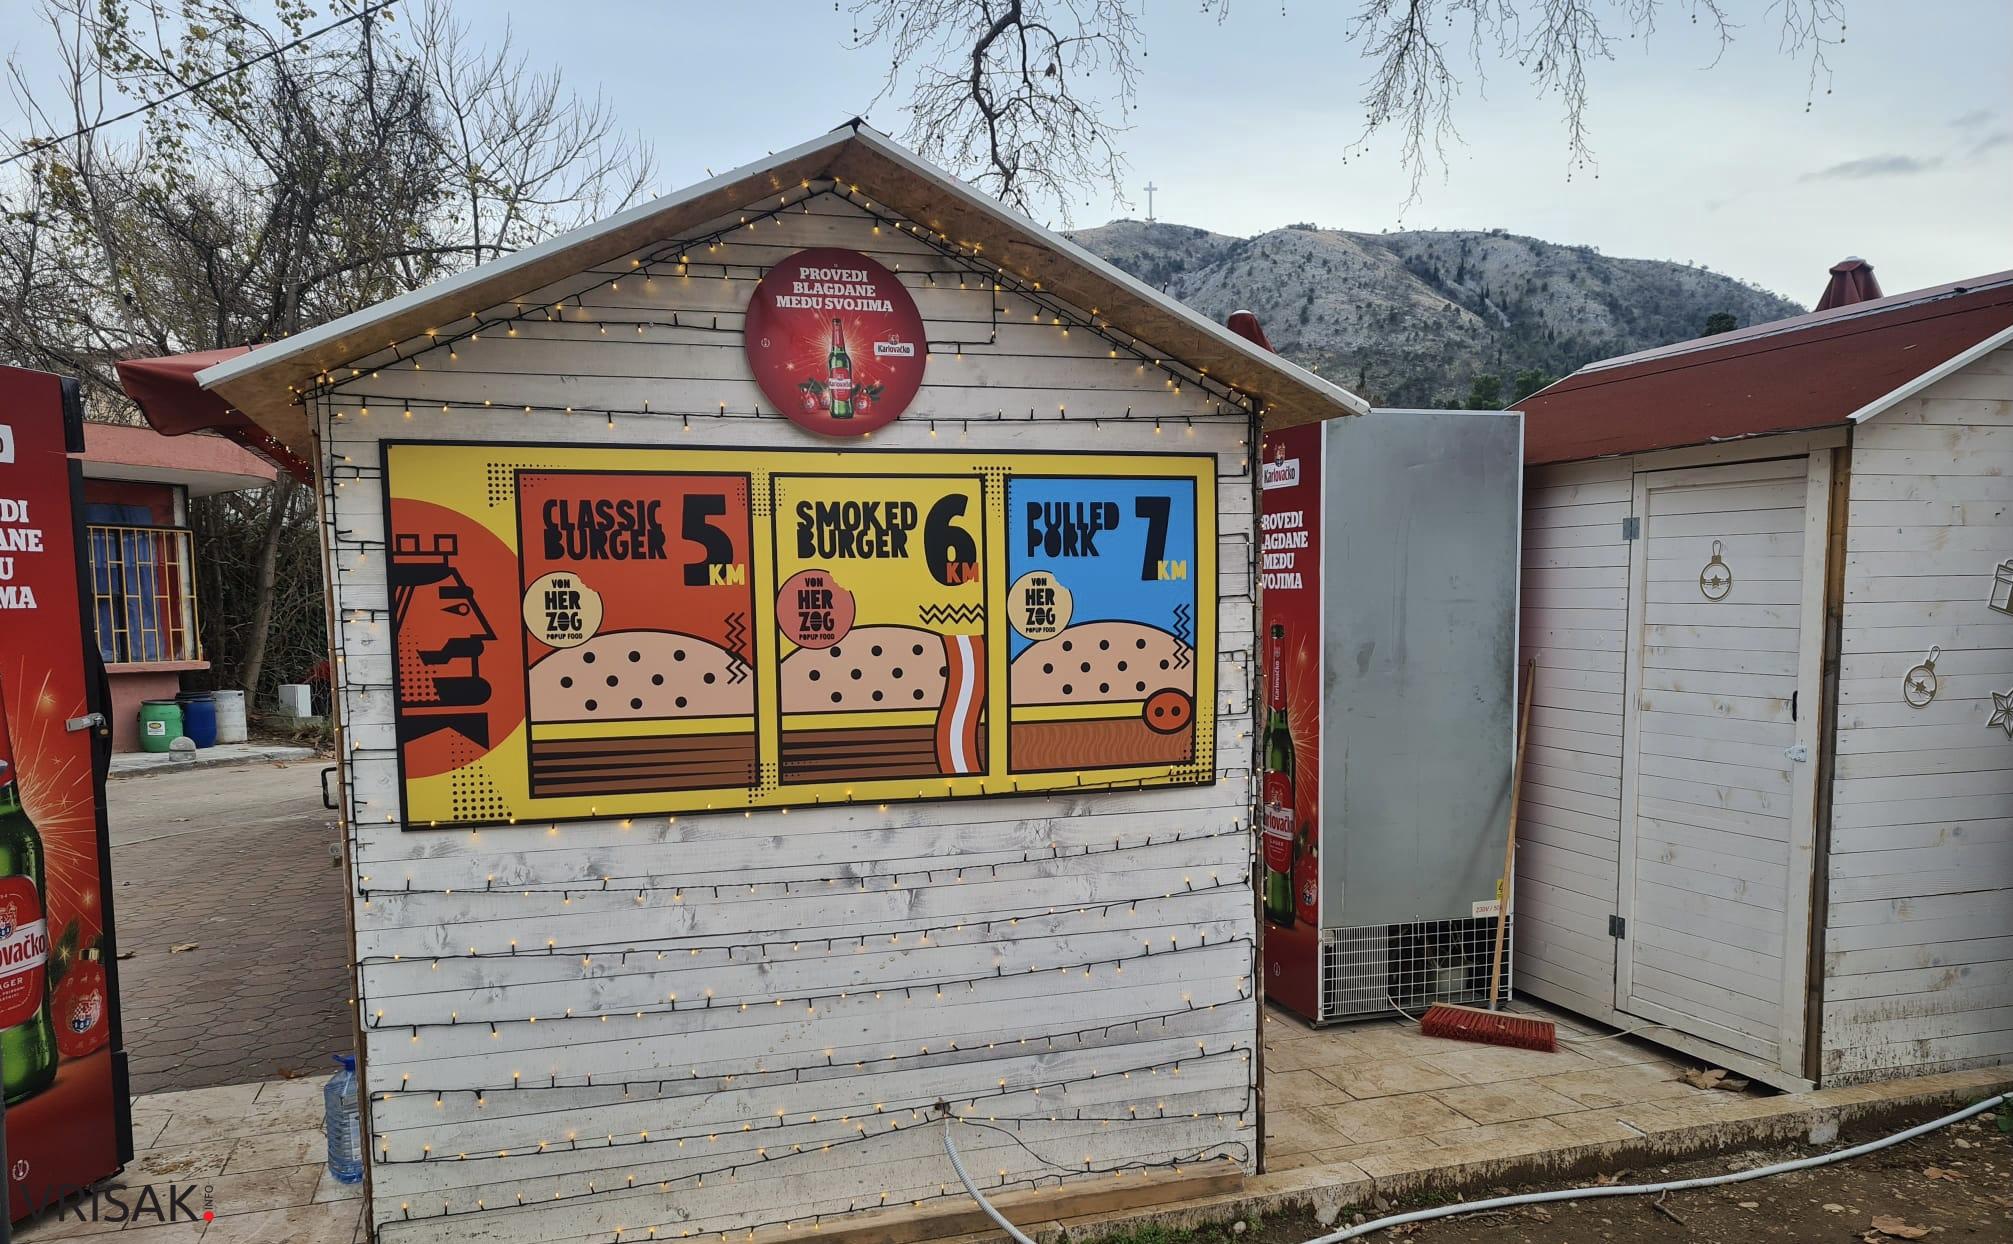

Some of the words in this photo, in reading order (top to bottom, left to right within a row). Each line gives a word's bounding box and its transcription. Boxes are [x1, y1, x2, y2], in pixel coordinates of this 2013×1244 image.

[800, 267, 868, 282] PROVEDI
[793, 281, 876, 297] BLAGDANE
[825, 297, 893, 312] SVOJIMA
[1264, 465, 1296, 483] Karlovačko
[0, 498, 29, 523] DI
[796, 500, 918, 531] SMOKED
[1261, 511, 1303, 530] ROVEDI
[543, 499, 662, 532] CLASSIC
[682, 494, 733, 586] 5
[709, 563, 745, 586] KM
[543, 526, 667, 561] BURGER
[797, 526, 909, 560] BURGER
[924, 493, 977, 586] 6
[1026, 501, 1120, 531] PULLED
[1135, 496, 1171, 581] 7
[1157, 559, 1187, 581] KM
[1027, 526, 1100, 558] PORK
[1262, 531, 1308, 550] AGDANE
[805, 577, 823, 587] VON
[946, 562, 979, 583] KM
[1031, 577, 1047, 586] VON
[1262, 573, 1303, 590] VOJIMA
[551, 579, 571, 589] VON
[544, 590, 581, 610] HER
[797, 589, 834, 609] HER
[1025, 588, 1055, 606] HER
[545, 611, 582, 631] ZOG
[798, 611, 834, 631] ZOG
[1025, 607, 1056, 625] ZOG
